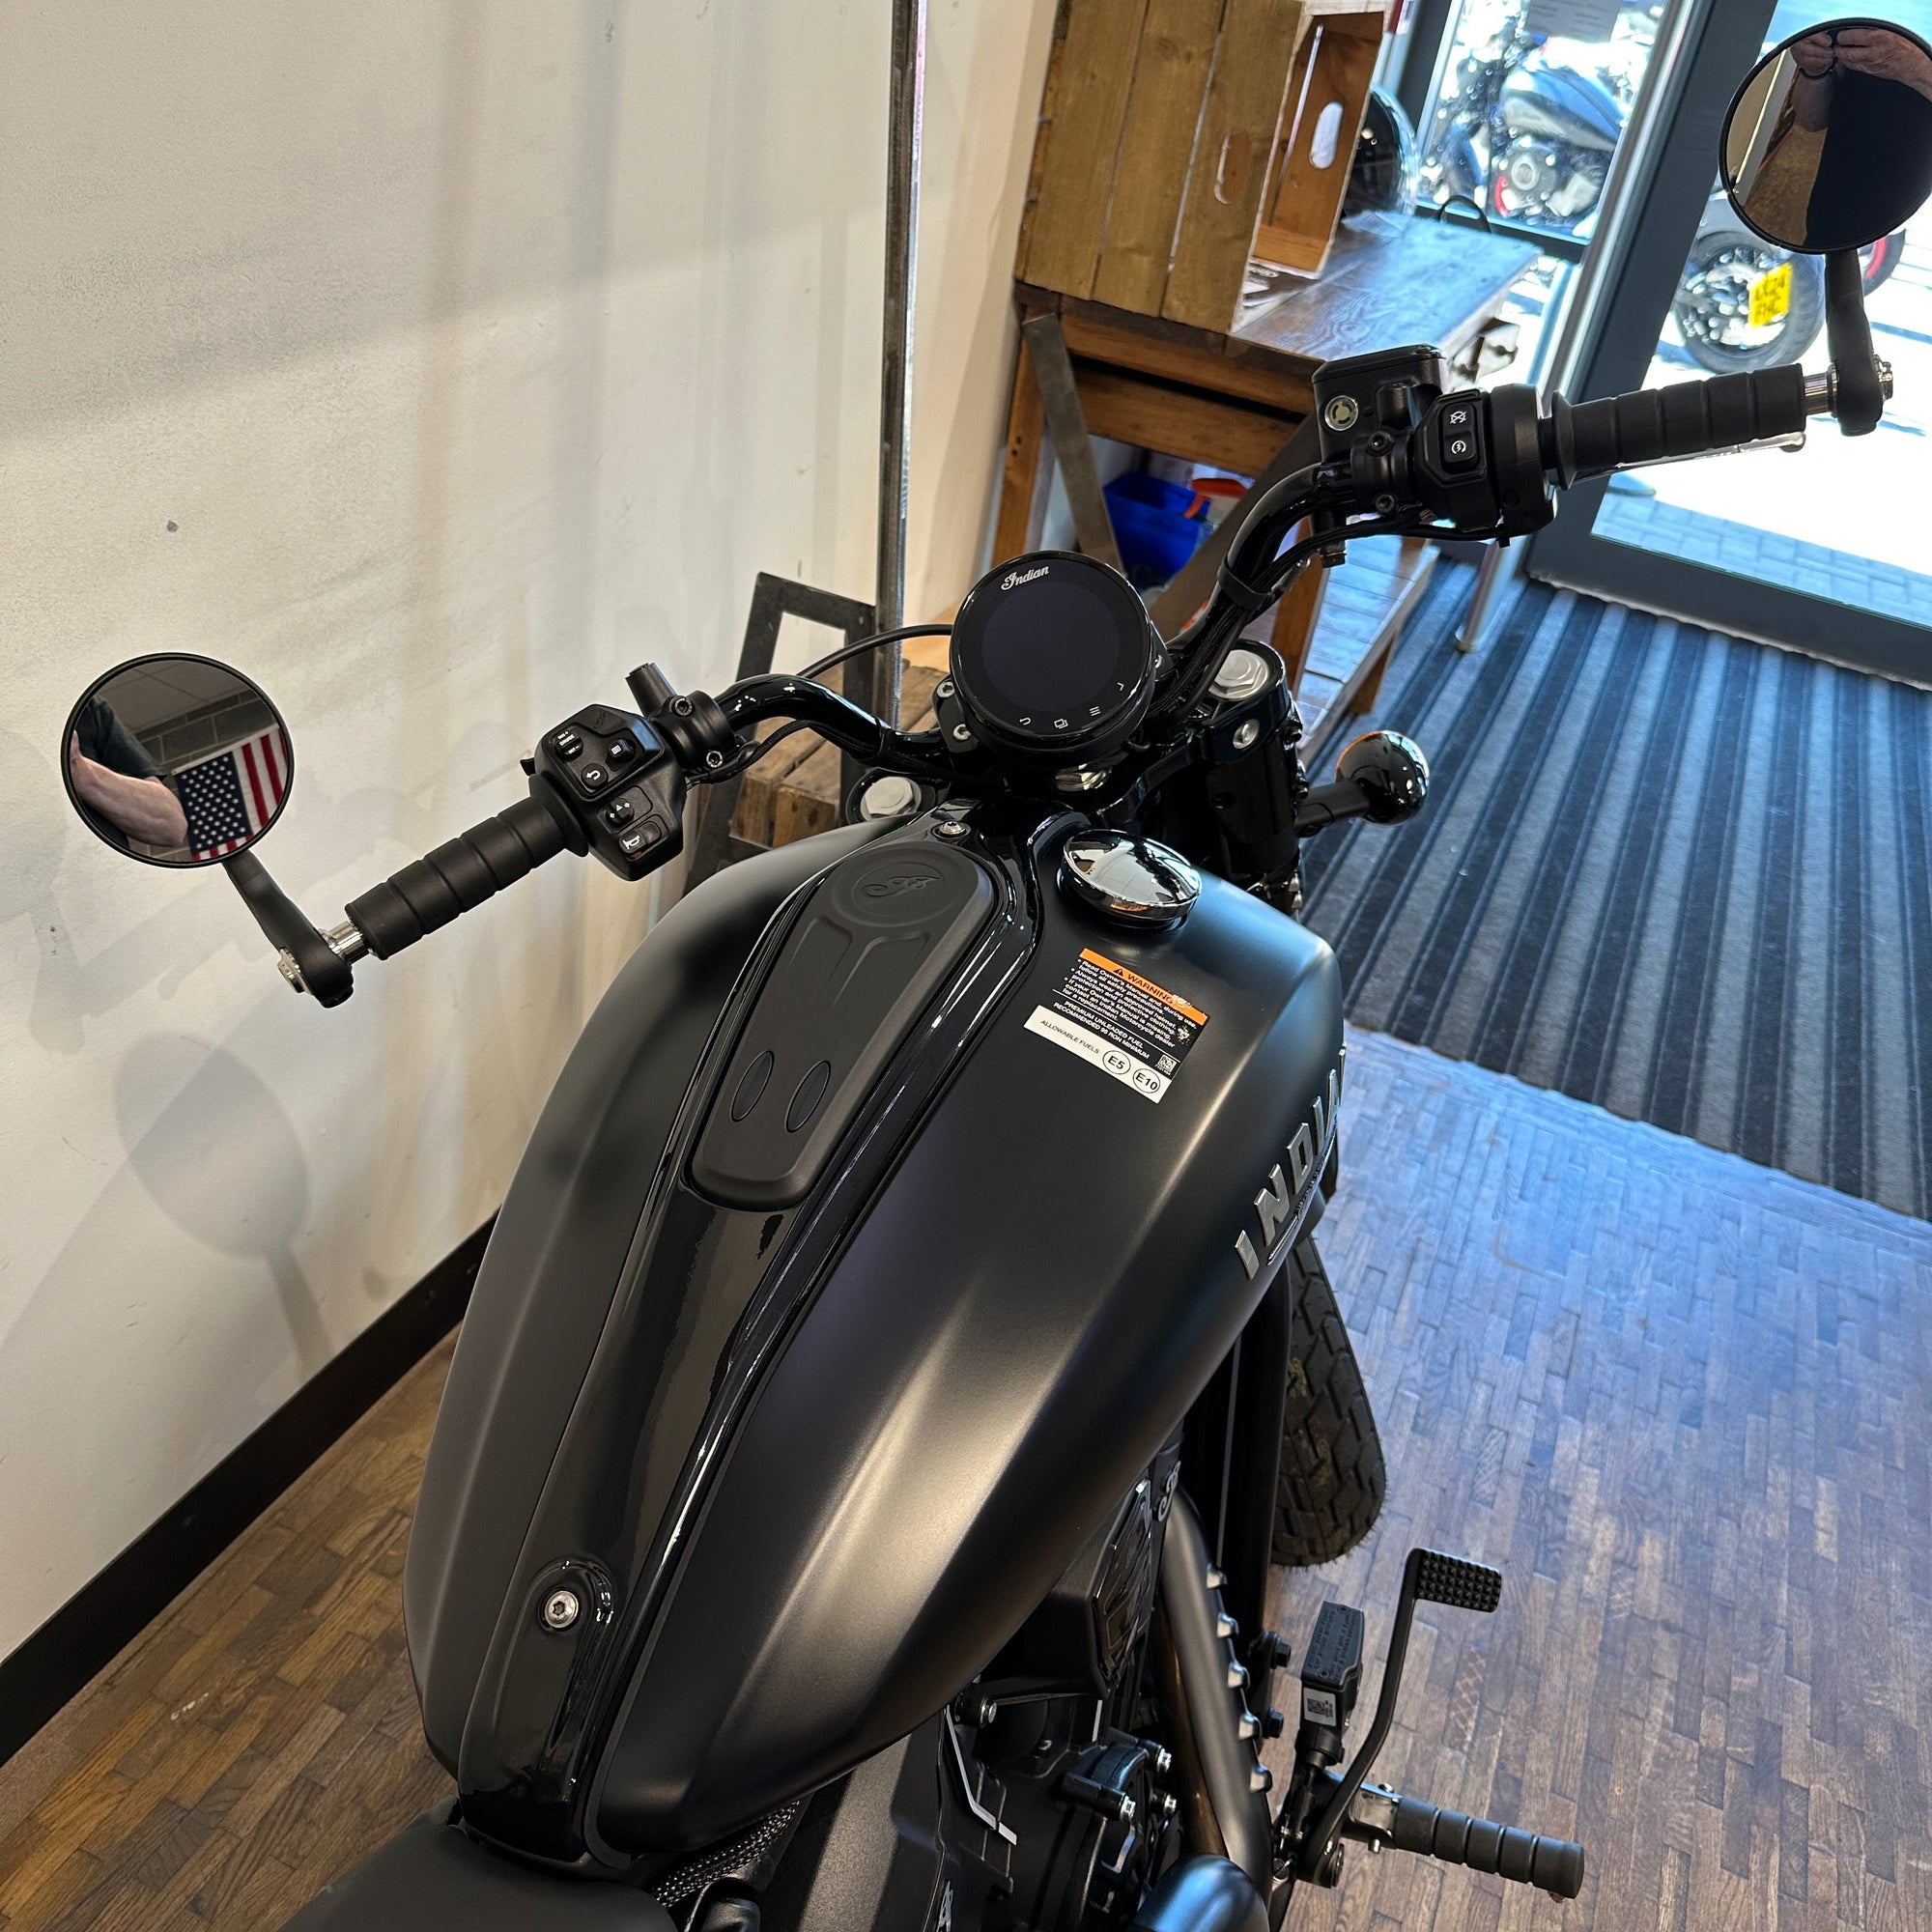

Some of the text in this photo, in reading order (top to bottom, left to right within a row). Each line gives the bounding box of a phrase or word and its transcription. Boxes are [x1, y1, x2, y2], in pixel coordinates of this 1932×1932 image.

[1001, 565, 1050, 591] Indian
[1062, 986, 1073, 996] for
[1070, 973, 1104, 994] protection
[1103, 990, 1118, 1001] and
[1116, 998, 1150, 1019] protective
[1074, 969, 1098, 984] Always
[1097, 981, 1114, 993] wear
[1122, 995, 1154, 1015] approved
[1078, 964, 1098, 978] follow
[1105, 979, 1126, 993] safety
[1081, 960, 1099, 973] Read
[1123, 983, 1149, 1000] Manual
[1161, 1006, 1184, 1021] during
[1064, 982, 1090, 999] contact
[1098, 1001, 1120, 1015] Indian
[1117, 1011, 1155, 1037] Motorcycle
[1152, 1033, 1176, 1048] dealer
[1072, 981, 1089, 993] your
[1114, 1004, 1139, 1020] Manual
[1039, 1017, 1099, 1054] ALLOWABLE FUELS
[1052, 1001, 1100, 1031] RECOMMENDED
[1106, 1031, 1122, 1042] RON
[1120, 1038, 1151, 1060] MINIMUM
[1064, 1000, 1145, 1049] PREMIUM UNLEADED FUEL
[1107, 1055, 1125, 1069] E5
[1134, 1071, 1158, 1091] E10
